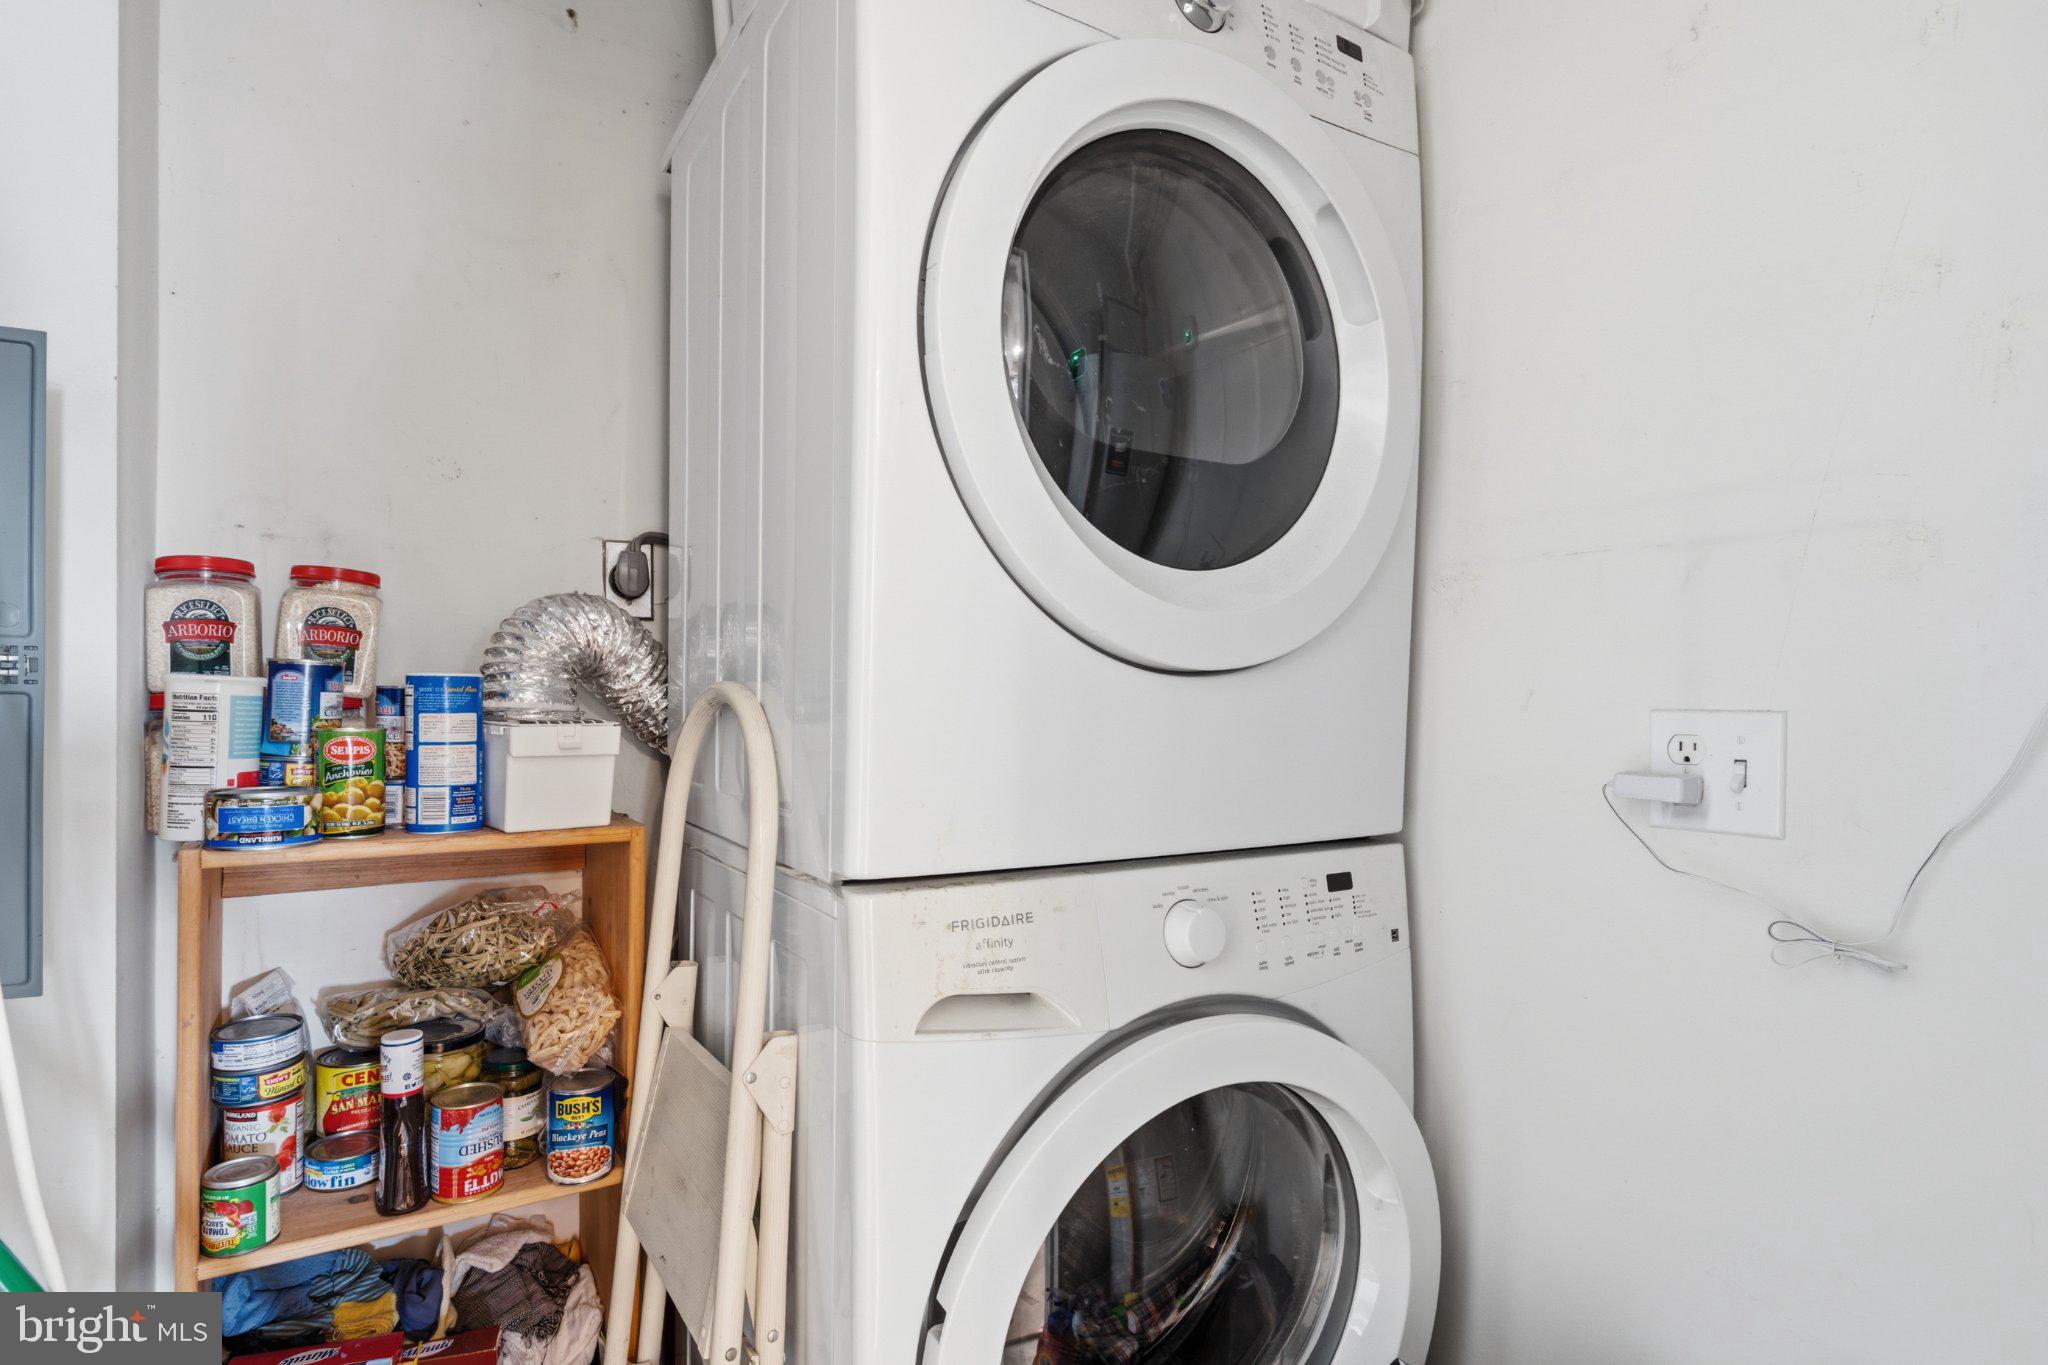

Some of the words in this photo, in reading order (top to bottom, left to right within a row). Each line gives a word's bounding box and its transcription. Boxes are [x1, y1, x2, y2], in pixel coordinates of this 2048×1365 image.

[167, 622, 233, 638] ARBORIO
[302, 628, 360, 645] ARBORIO
[202, 713, 217, 721] 110
[227, 815, 258, 825] BREAST
[260, 812, 295, 823] CHICKEN
[239, 834, 283, 845] KIRKLAND
[951, 911, 1034, 933] FRIGIDAIRE
[341, 1068, 380, 1087] CEN
[331, 1099, 354, 1116] SAN
[557, 1099, 600, 1117] BUSH'S
[458, 1131, 504, 1157] RUSHED
[551, 1132, 587, 1143] Blackeye
[588, 1129, 608, 1140] Peas
